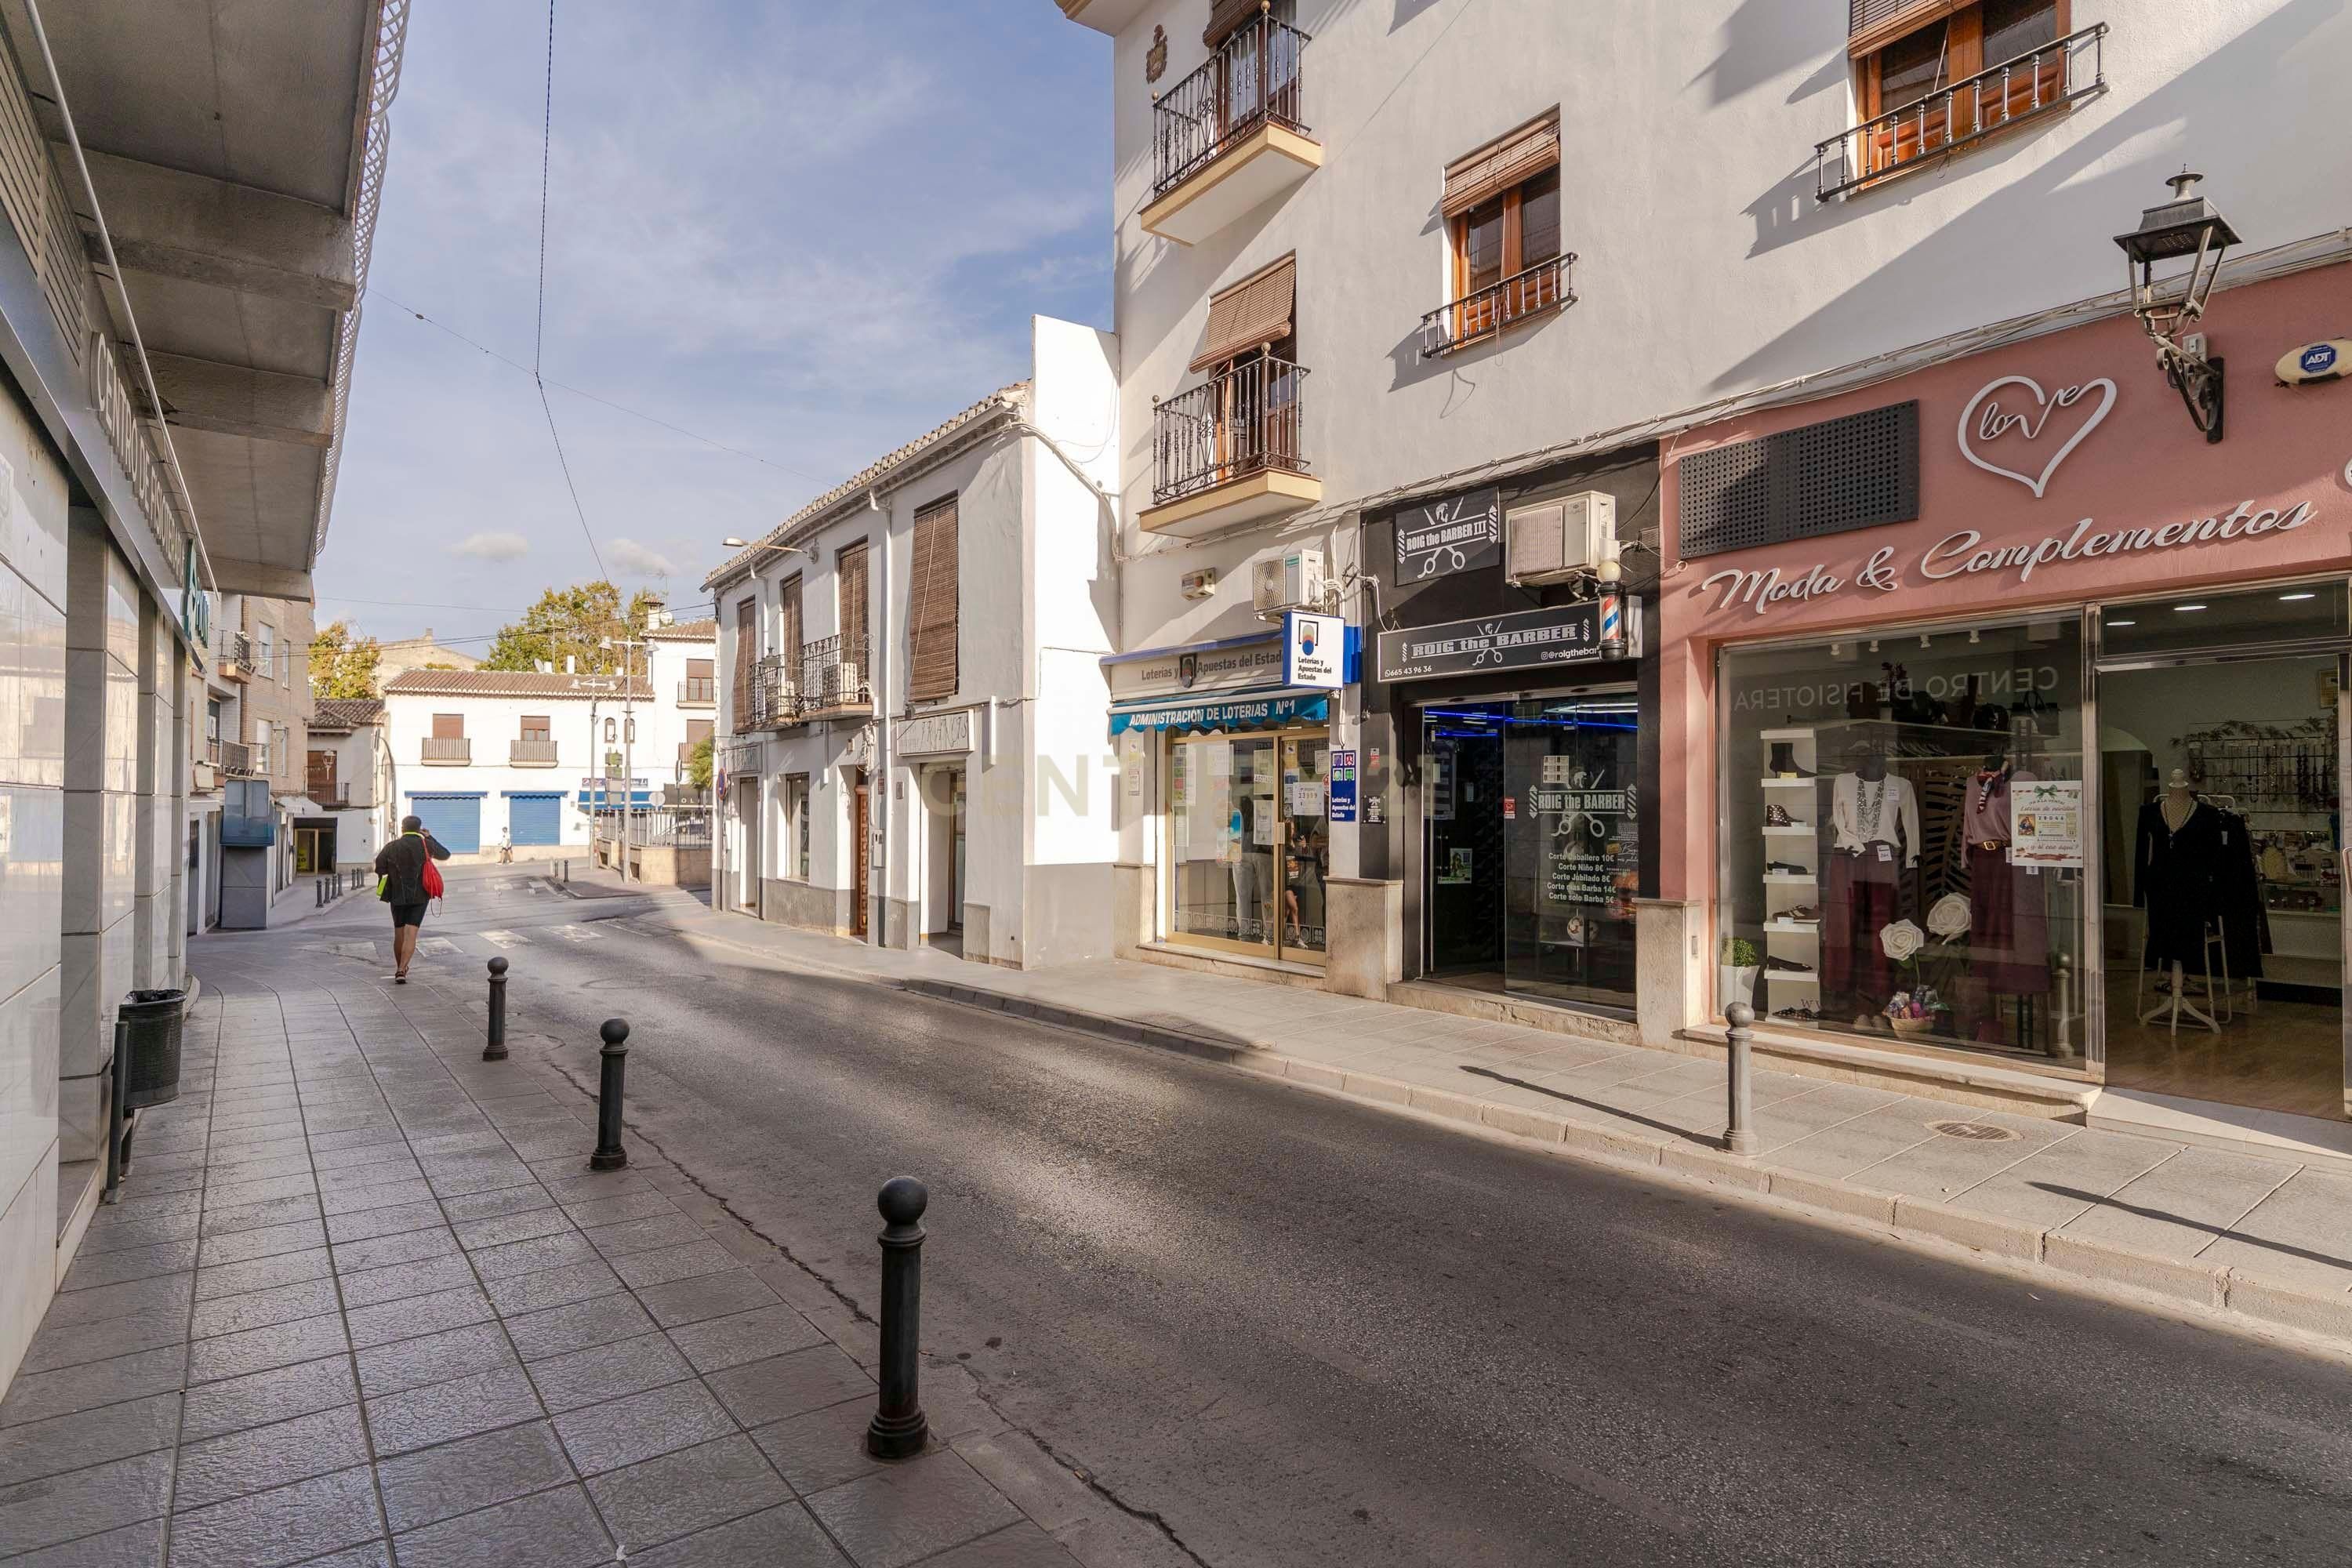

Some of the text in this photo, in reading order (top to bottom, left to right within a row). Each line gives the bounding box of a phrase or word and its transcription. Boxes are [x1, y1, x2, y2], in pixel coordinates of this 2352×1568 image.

[2306, 351, 2331, 365] ADT
[1406, 520, 1487, 551] ROIG the BARBER III
[1702, 499, 2318, 615] Moda & Complementos
[1411, 626, 1577, 658] ROIG the BARBER
[1174, 666, 1179, 679] y
[1196, 658, 1236, 674] Apuestas
[1239, 655, 1253, 668] del
[1255, 650, 1282, 666] Estad
[1298, 665, 1323, 673] Apuestas
[1129, 707, 1204, 727] ADMINISTRACIÓN
[1207, 707, 1219, 720] DE
[1222, 702, 1268, 720] LOTERIAS
[1538, 794, 1625, 810] ROIG the BARBER
[1568, 853, 1599, 862] Caballero
[1577, 863, 1594, 872] Niño
[1572, 873, 1600, 882] Jubilado
[1547, 882, 1565, 891] Corte
[1581, 884, 1602, 893] Barba
[1568, 893, 1582, 902] solo
[1584, 895, 1603, 903] Barba
